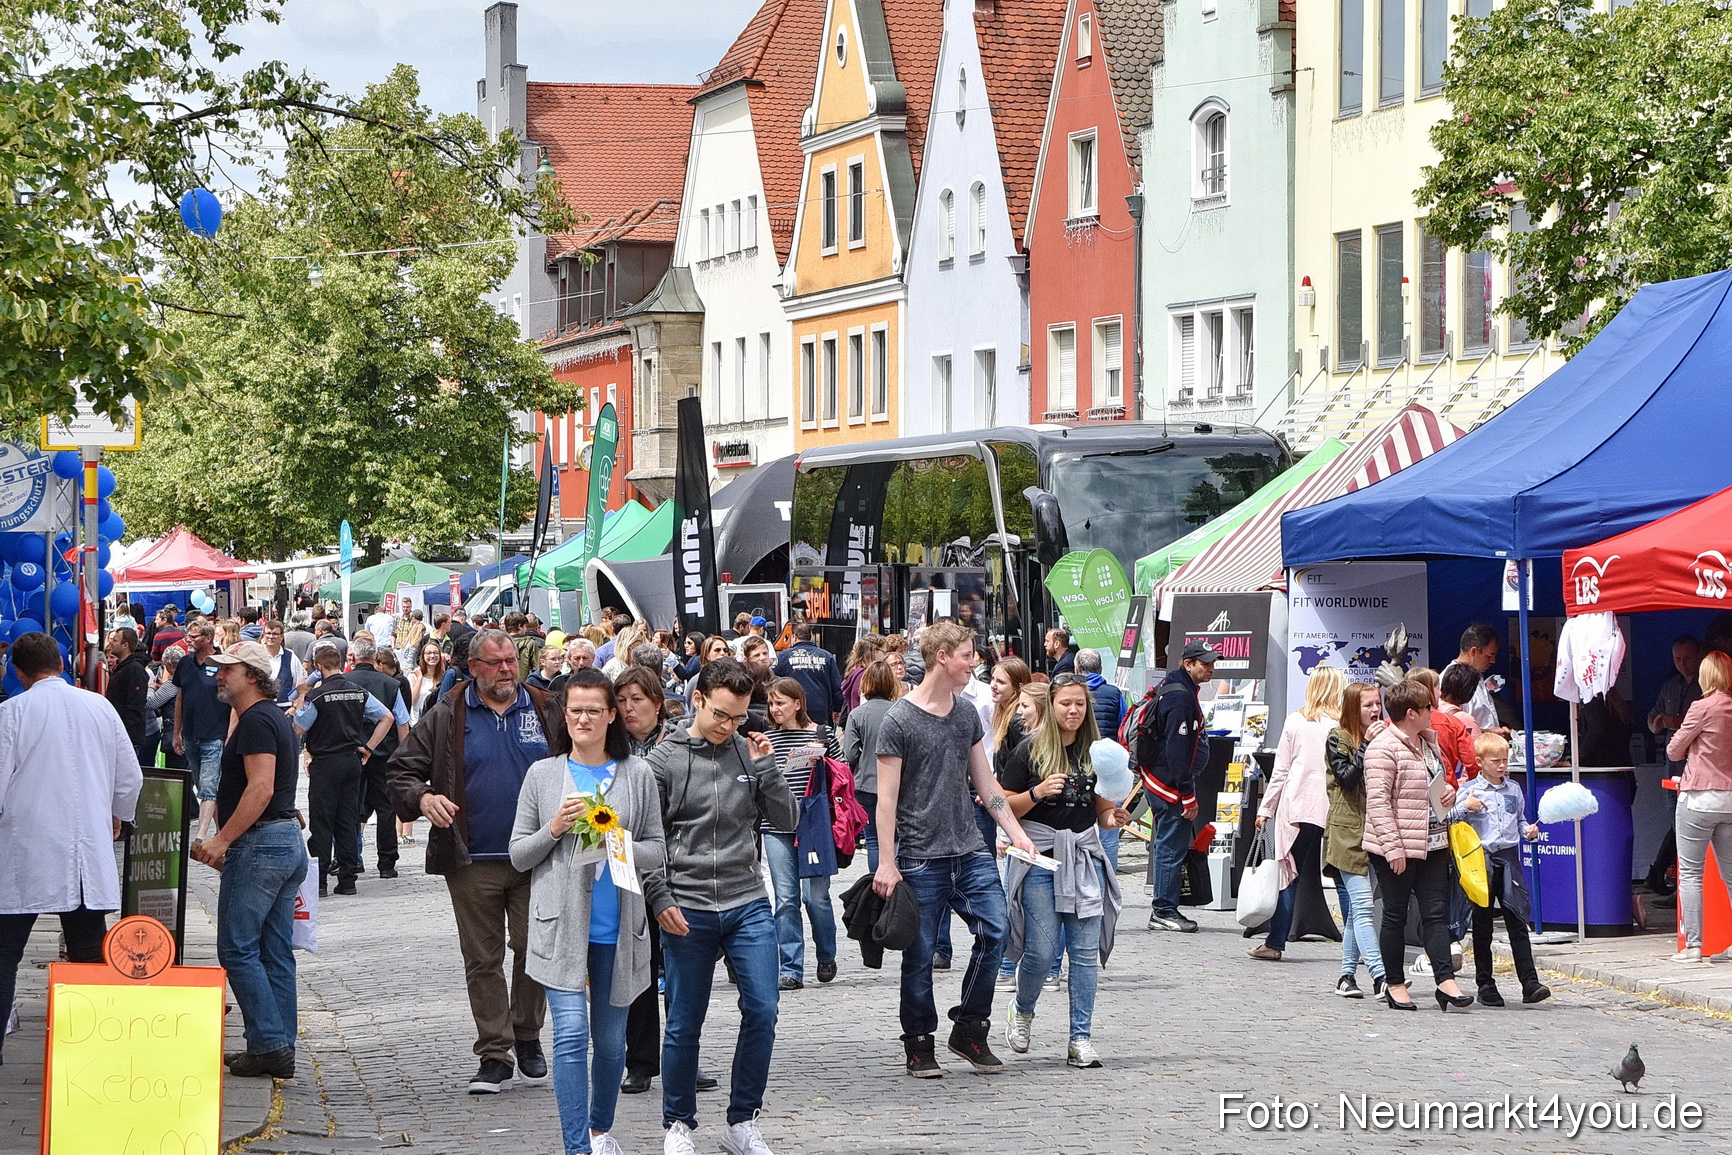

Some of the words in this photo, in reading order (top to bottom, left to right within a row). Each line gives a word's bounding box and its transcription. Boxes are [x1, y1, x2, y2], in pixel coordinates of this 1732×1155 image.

[0, 460, 50, 484] STER
[1307, 574, 1323, 583] FIT
[1694, 567, 1727, 600] LBS
[1574, 576, 1601, 606] LBS
[1293, 597, 1311, 608] FIT
[1314, 597, 1389, 608] WORLDWIDE
[1222, 636, 1250, 658] BONA
[1339, 668, 1378, 676] EADQUART
[129, 833, 154, 855] BACK
[1522, 844, 1577, 856] MAFACTURIN
[129, 859, 166, 882] JUNGS!
[58, 990, 192, 1045] Döner
[65, 1055, 203, 1119] Kebap
